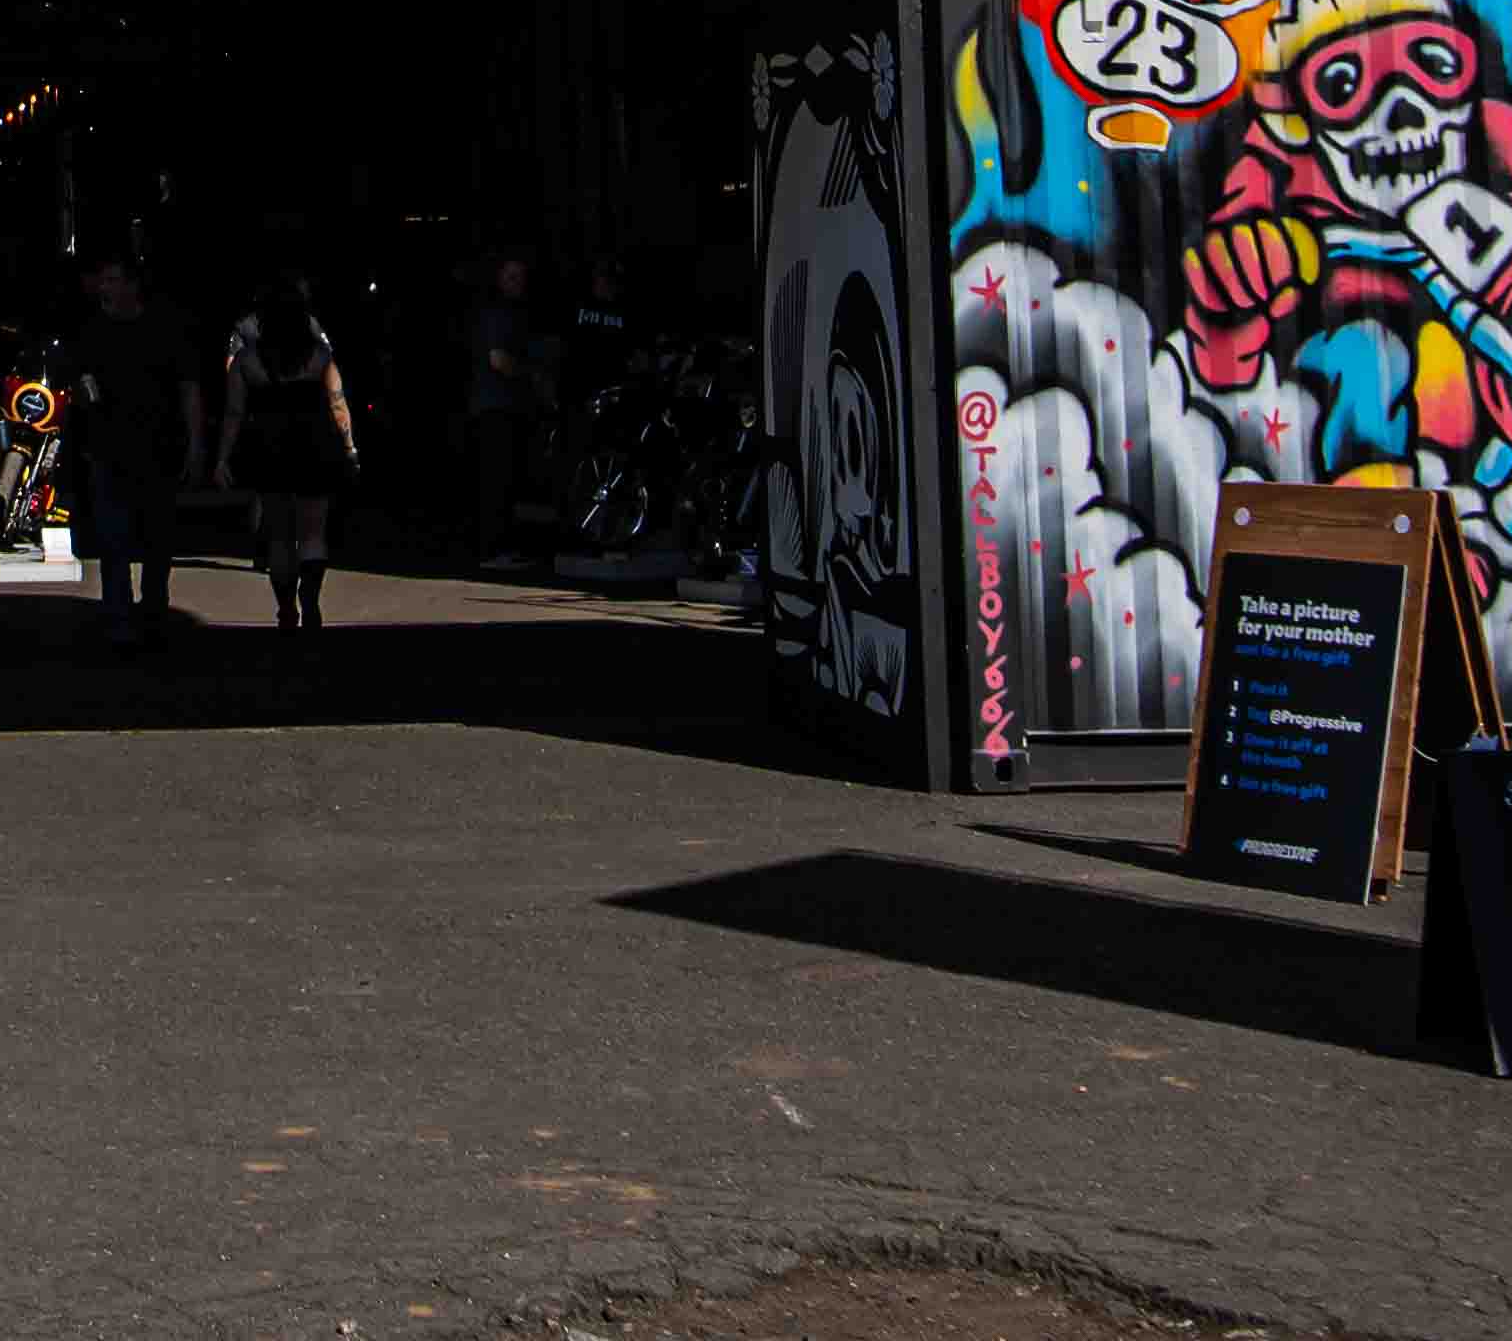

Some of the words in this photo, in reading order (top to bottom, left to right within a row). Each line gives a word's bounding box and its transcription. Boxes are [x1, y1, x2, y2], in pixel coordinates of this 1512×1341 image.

[1444, 201, 1504, 266] 1
[1239, 595, 1279, 615] Take
[1280, 601, 1292, 616] a
[1294, 600, 1361, 623] picture
[1237, 616, 1263, 635] for
[1265, 622, 1305, 642] your
[1306, 626, 1376, 647] mother
[1269, 708, 1364, 734] @Progressive
